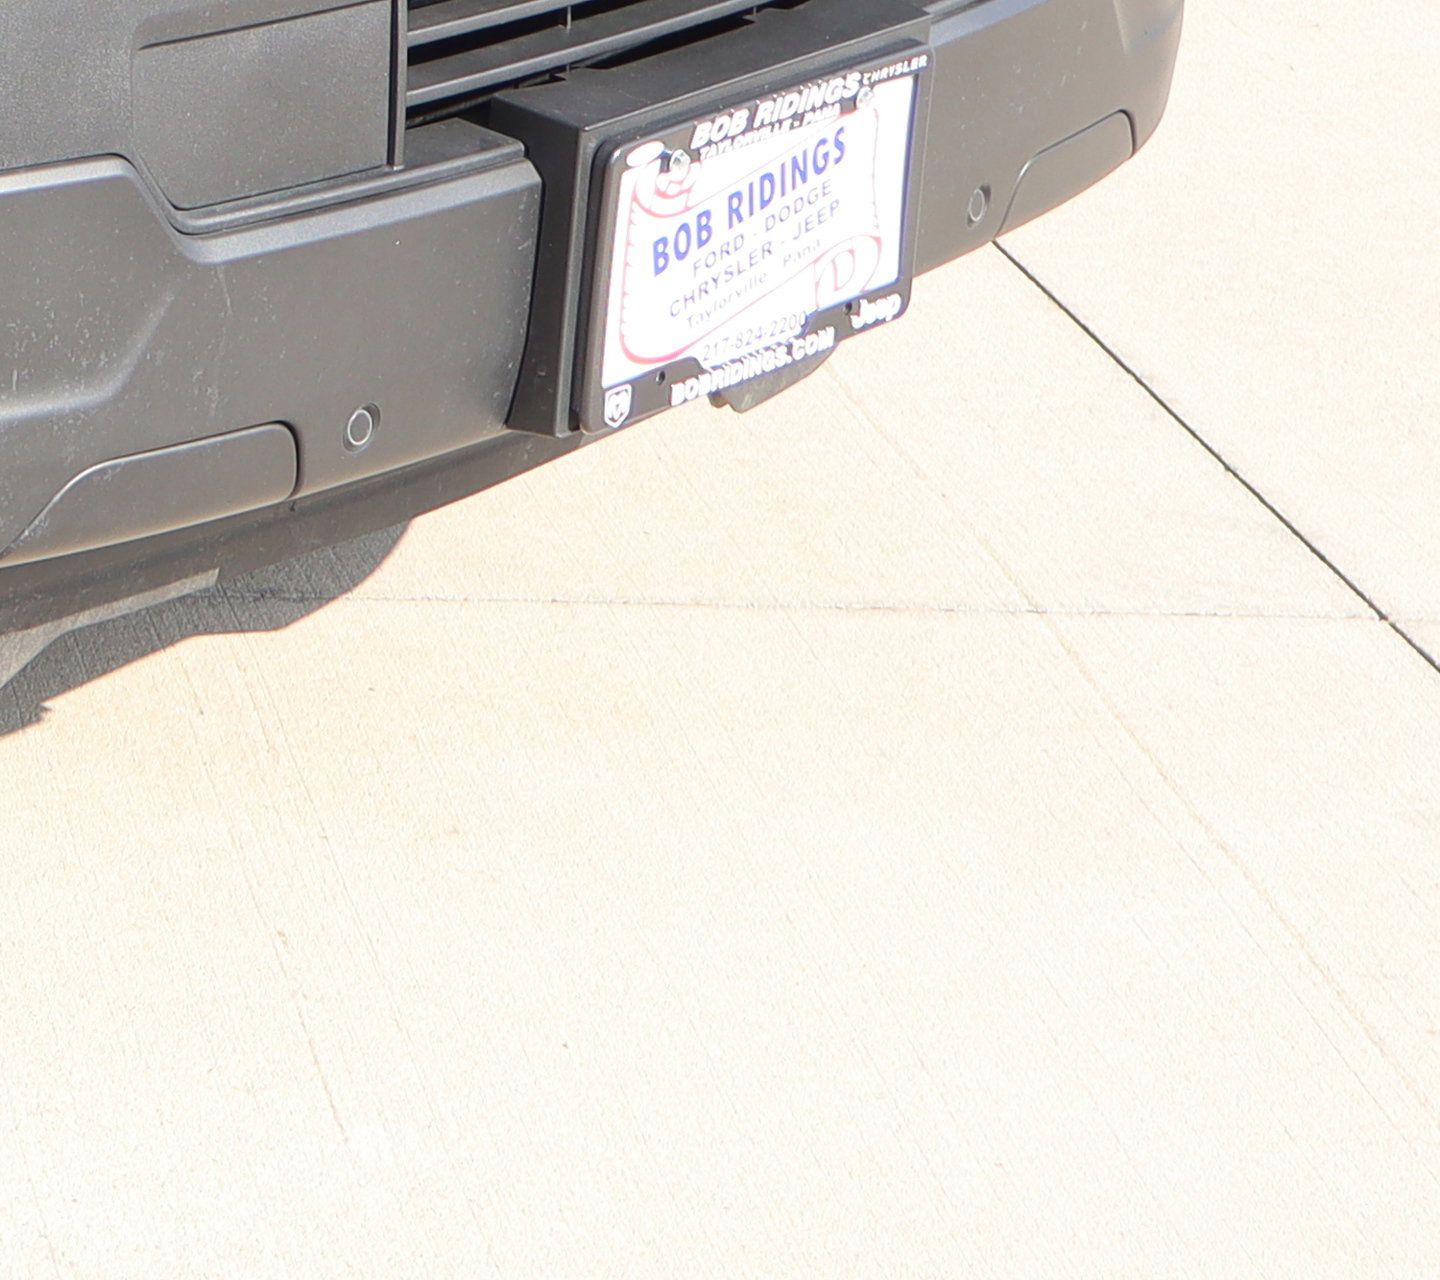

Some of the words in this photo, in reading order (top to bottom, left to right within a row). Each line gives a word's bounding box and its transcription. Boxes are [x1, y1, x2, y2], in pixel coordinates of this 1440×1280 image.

[691, 107, 750, 150] BOB
[753, 71, 862, 128] RIDINGS
[863, 54, 928, 85] CHRYSLER
[653, 209, 713, 277] BOB
[728, 126, 846, 230] RIDINGS
[693, 233, 745, 278] FORD
[765, 178, 832, 233] DODGE
[670, 241, 773, 318] CHRYSLER
[792, 199, 841, 241] JEEP
[686, 272, 769, 329] Taylorville
[703, 311, 808, 362] 217-824-2200
[850, 293, 902, 329] Jeep
[670, 326, 835, 407] BOBRIDINGS.COM
